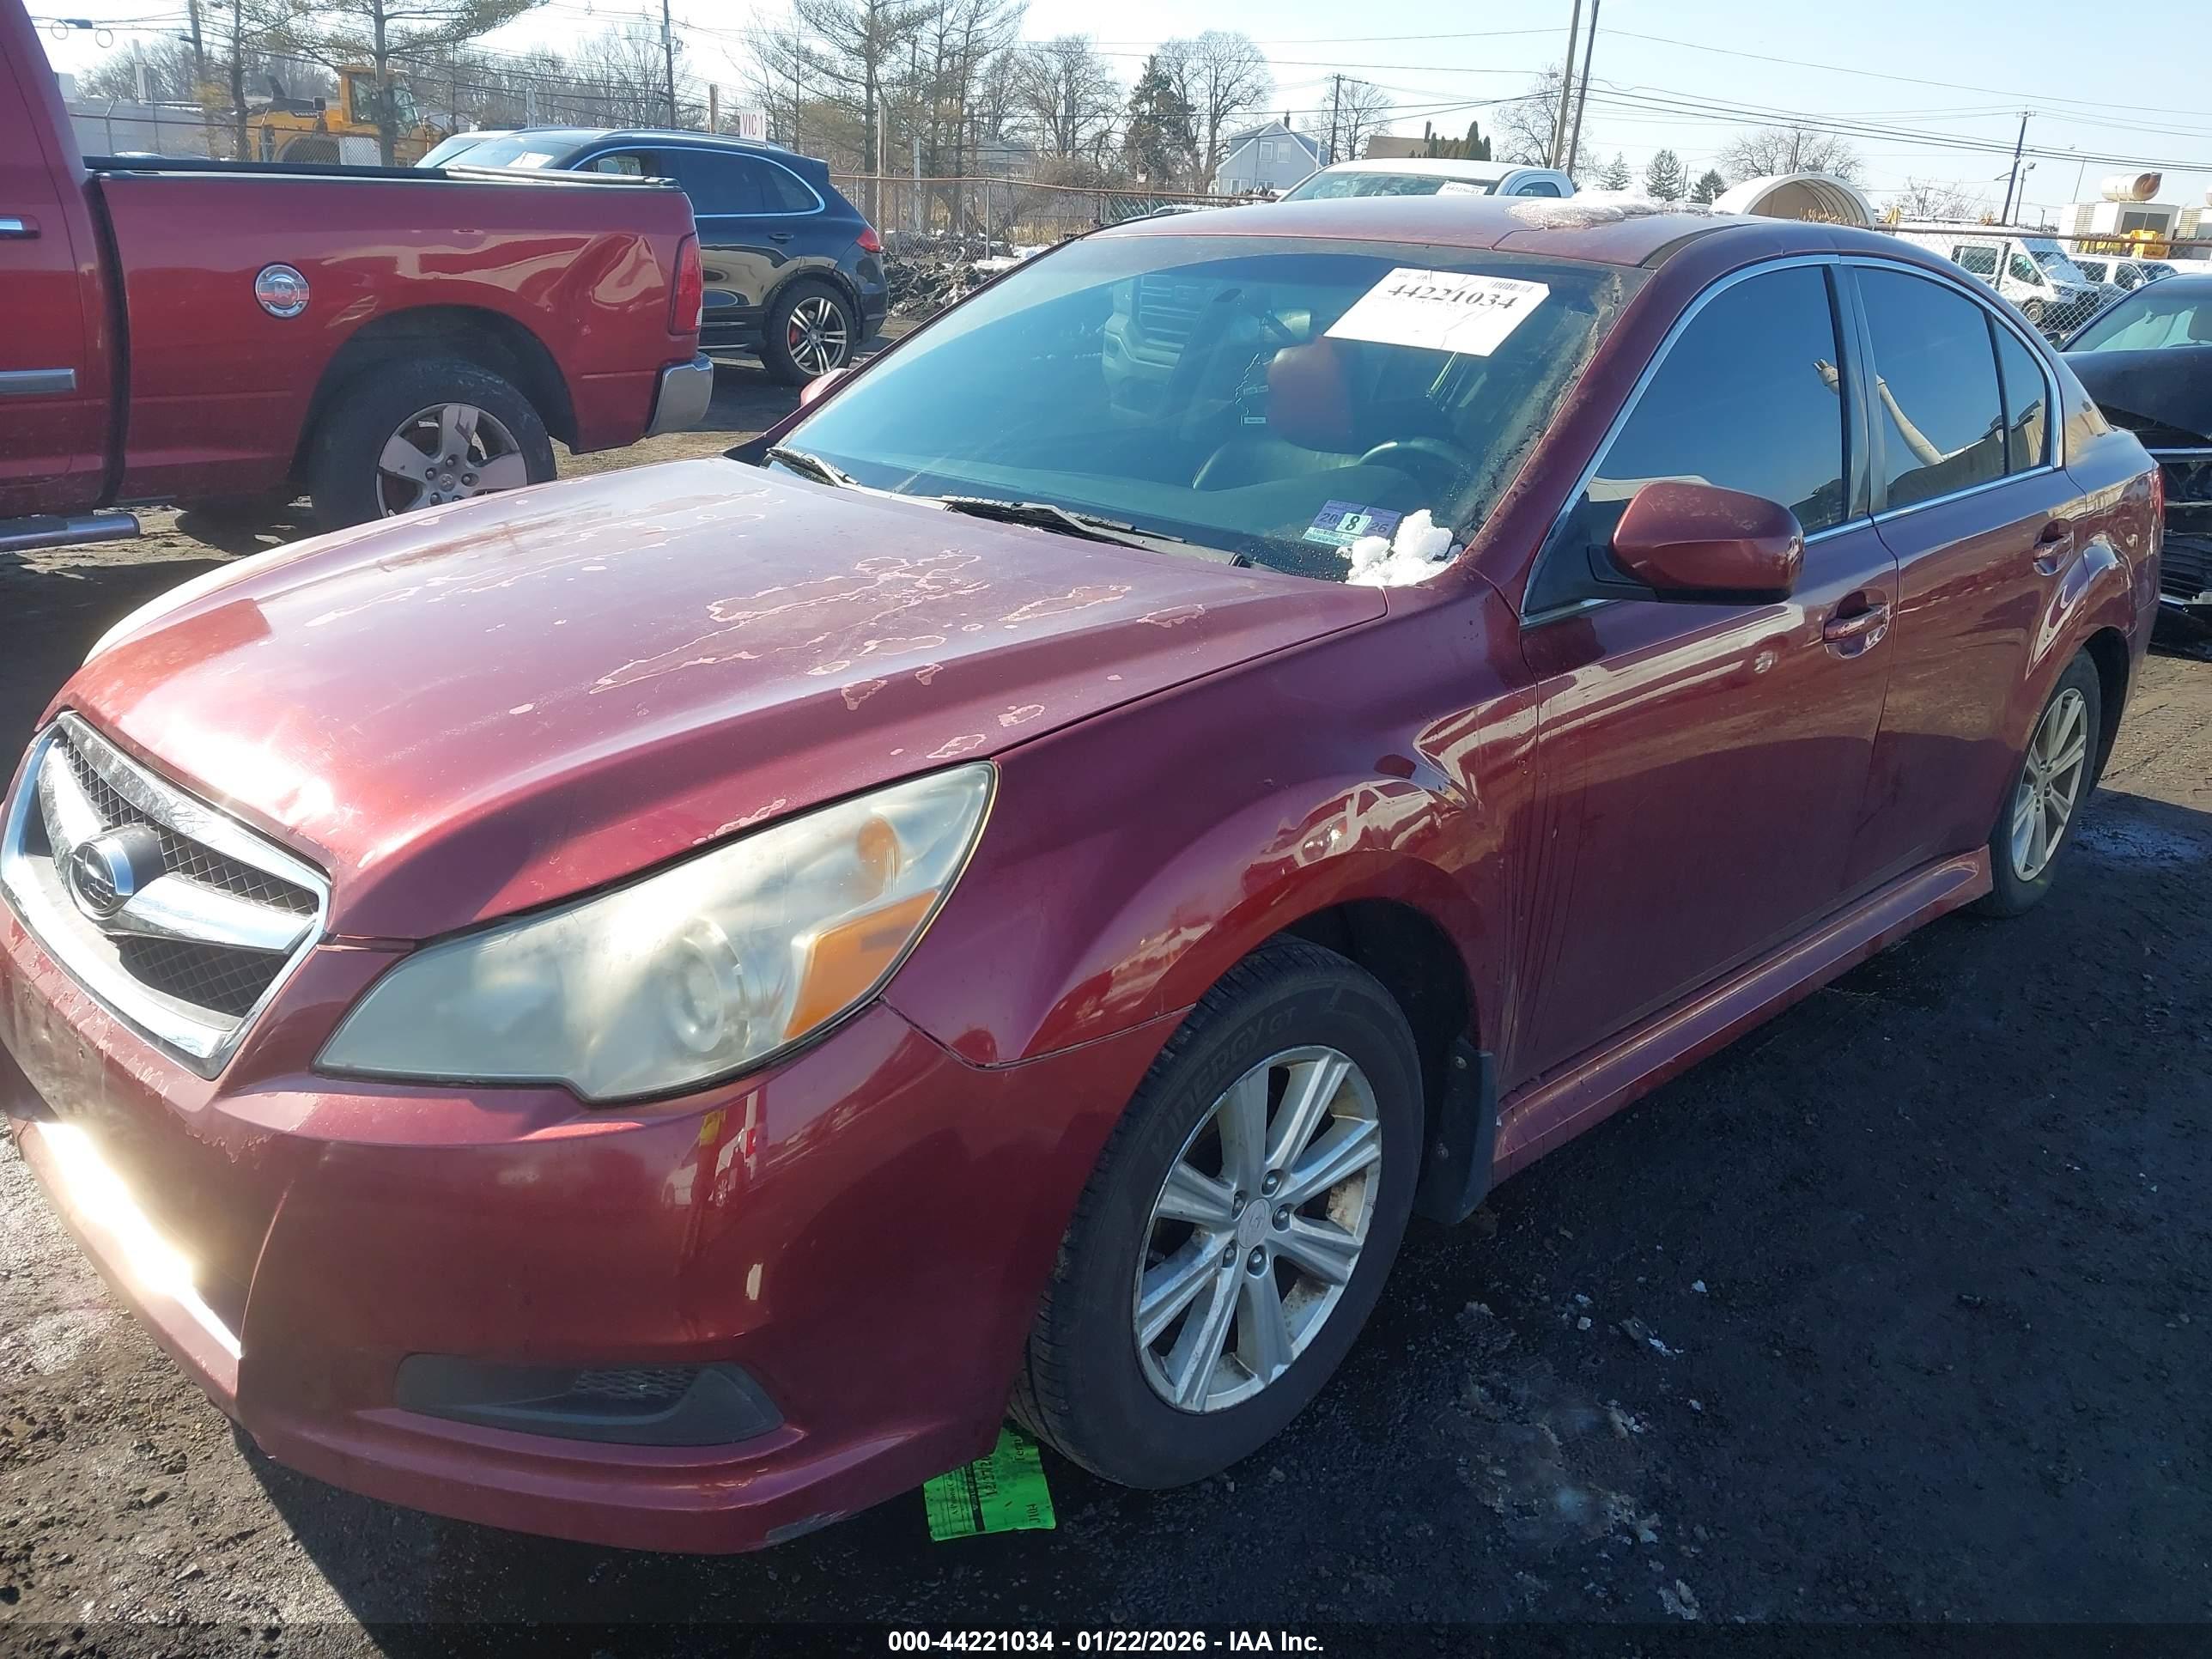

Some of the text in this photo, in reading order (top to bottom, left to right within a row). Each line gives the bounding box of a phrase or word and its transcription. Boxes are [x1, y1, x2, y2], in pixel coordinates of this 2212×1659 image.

[743, 113, 763, 136] VIC 1
[1387, 283, 1518, 309] 44221034
[1345, 515, 1360, 531] 8
[1368, 522, 1388, 533] 26
